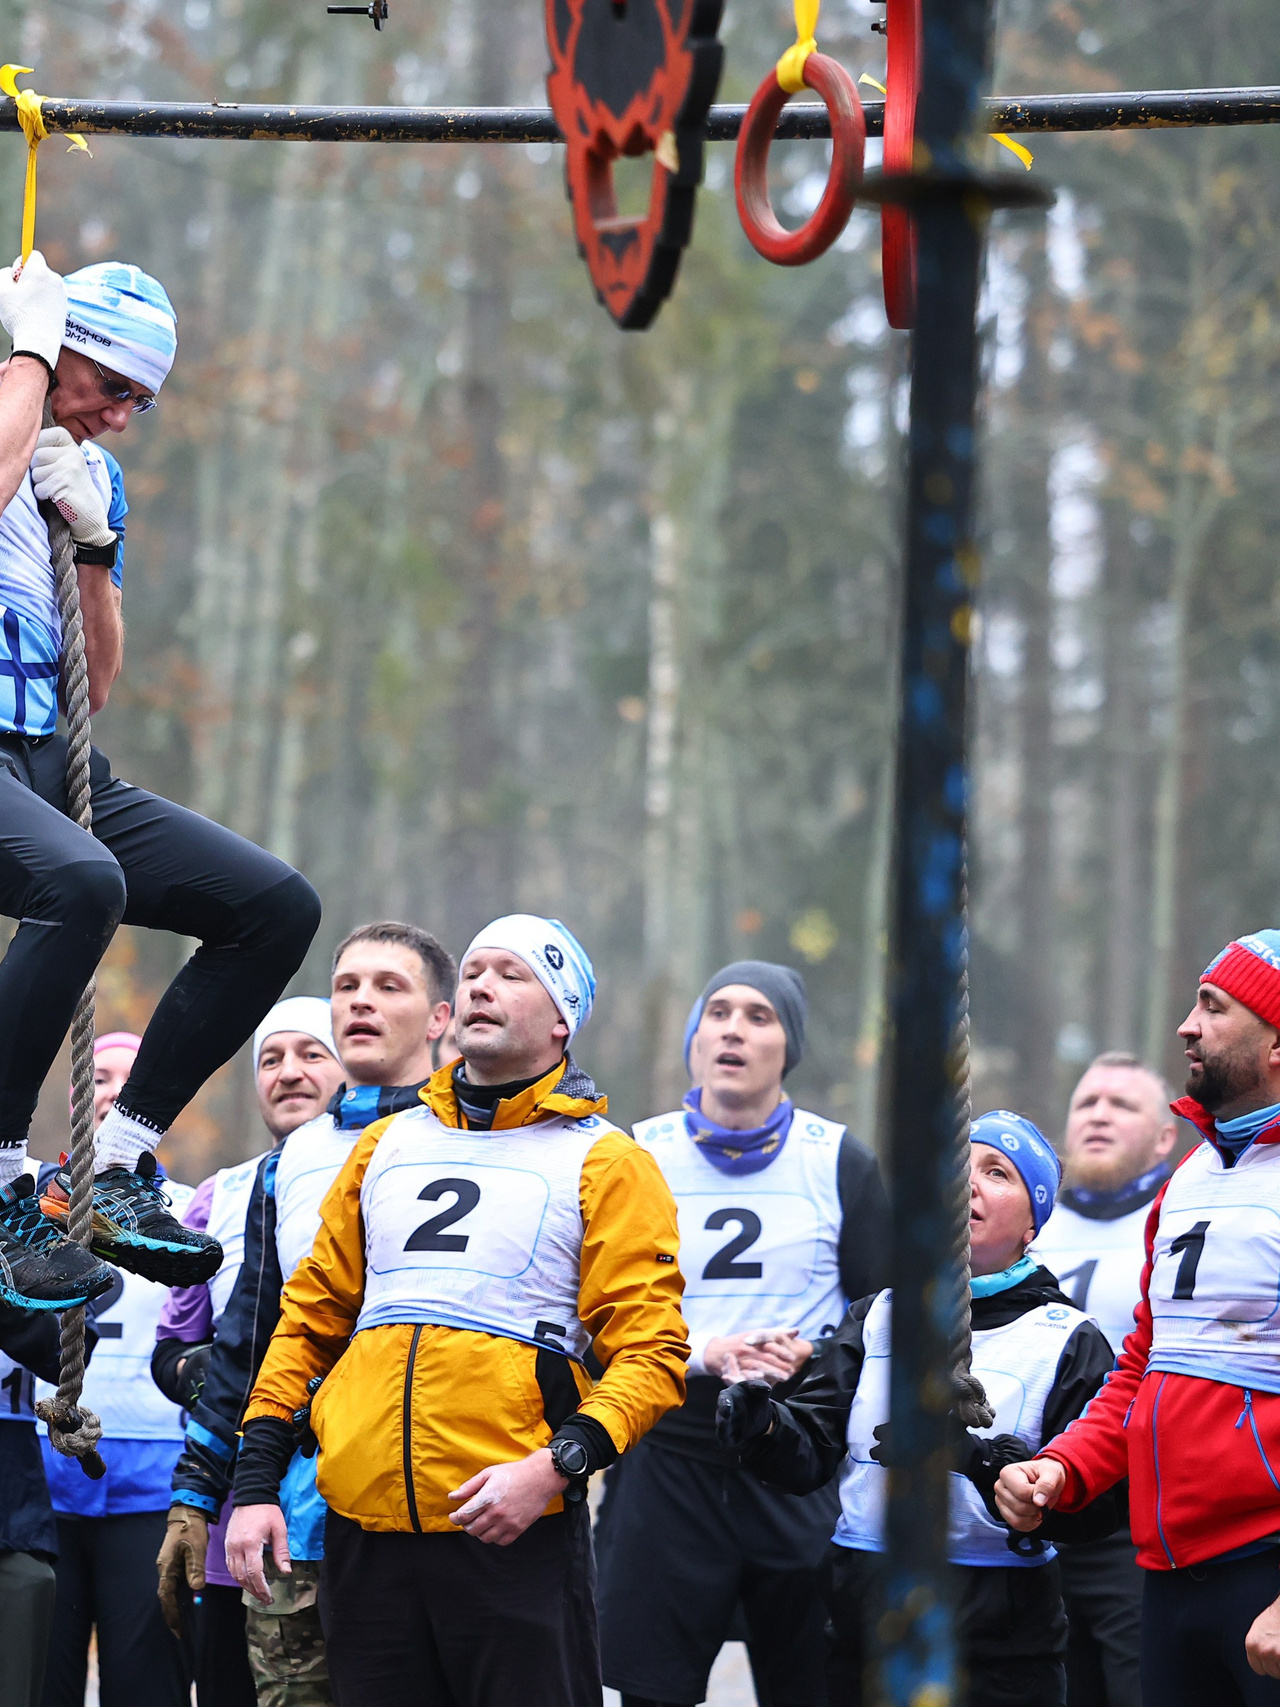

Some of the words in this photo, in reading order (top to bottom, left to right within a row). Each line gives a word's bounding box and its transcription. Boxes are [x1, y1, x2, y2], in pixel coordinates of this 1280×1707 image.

[531, 949, 557, 985] РОСАТОМ
[562, 1124, 596, 1137] РОСАТОМ
[403, 1177, 481, 1253] 2
[701, 1207, 763, 1280] 2
[1167, 1220, 1212, 1301] 1
[1058, 1258, 1100, 1313] 1
[1034, 1321, 1068, 1330] РОСАТОМ
